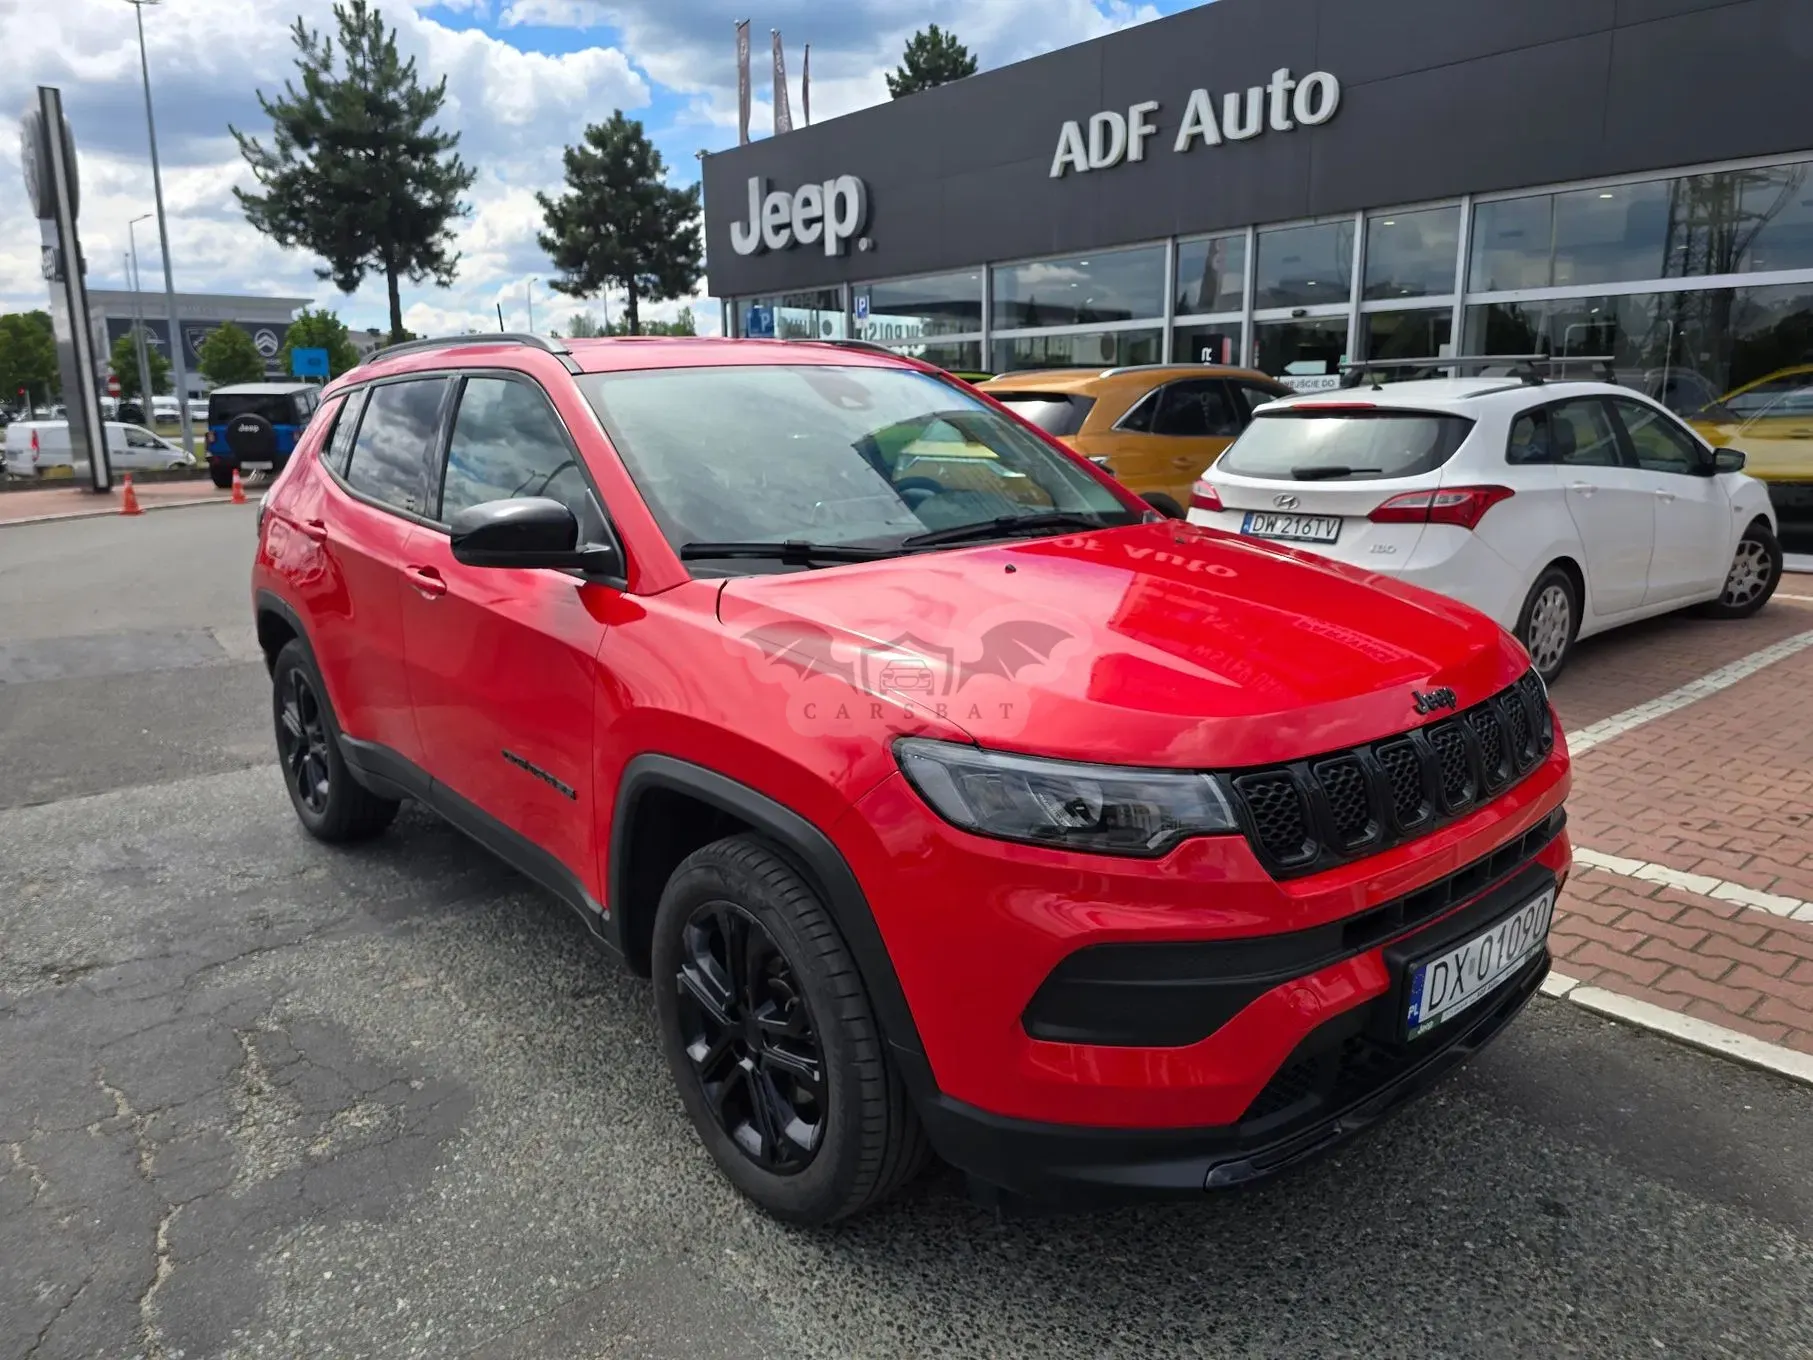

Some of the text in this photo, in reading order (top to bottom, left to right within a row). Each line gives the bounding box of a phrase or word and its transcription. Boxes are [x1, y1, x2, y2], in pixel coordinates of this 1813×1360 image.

[1049, 67, 1341, 178] ADF Auto
[730, 174, 867, 256] Jeep
[1253, 514, 1337, 537] DW 216TV
[1411, 686, 1457, 715] Jeep
[1428, 896, 1549, 1012] DX 01090
[1407, 1003, 1419, 1020] PL
